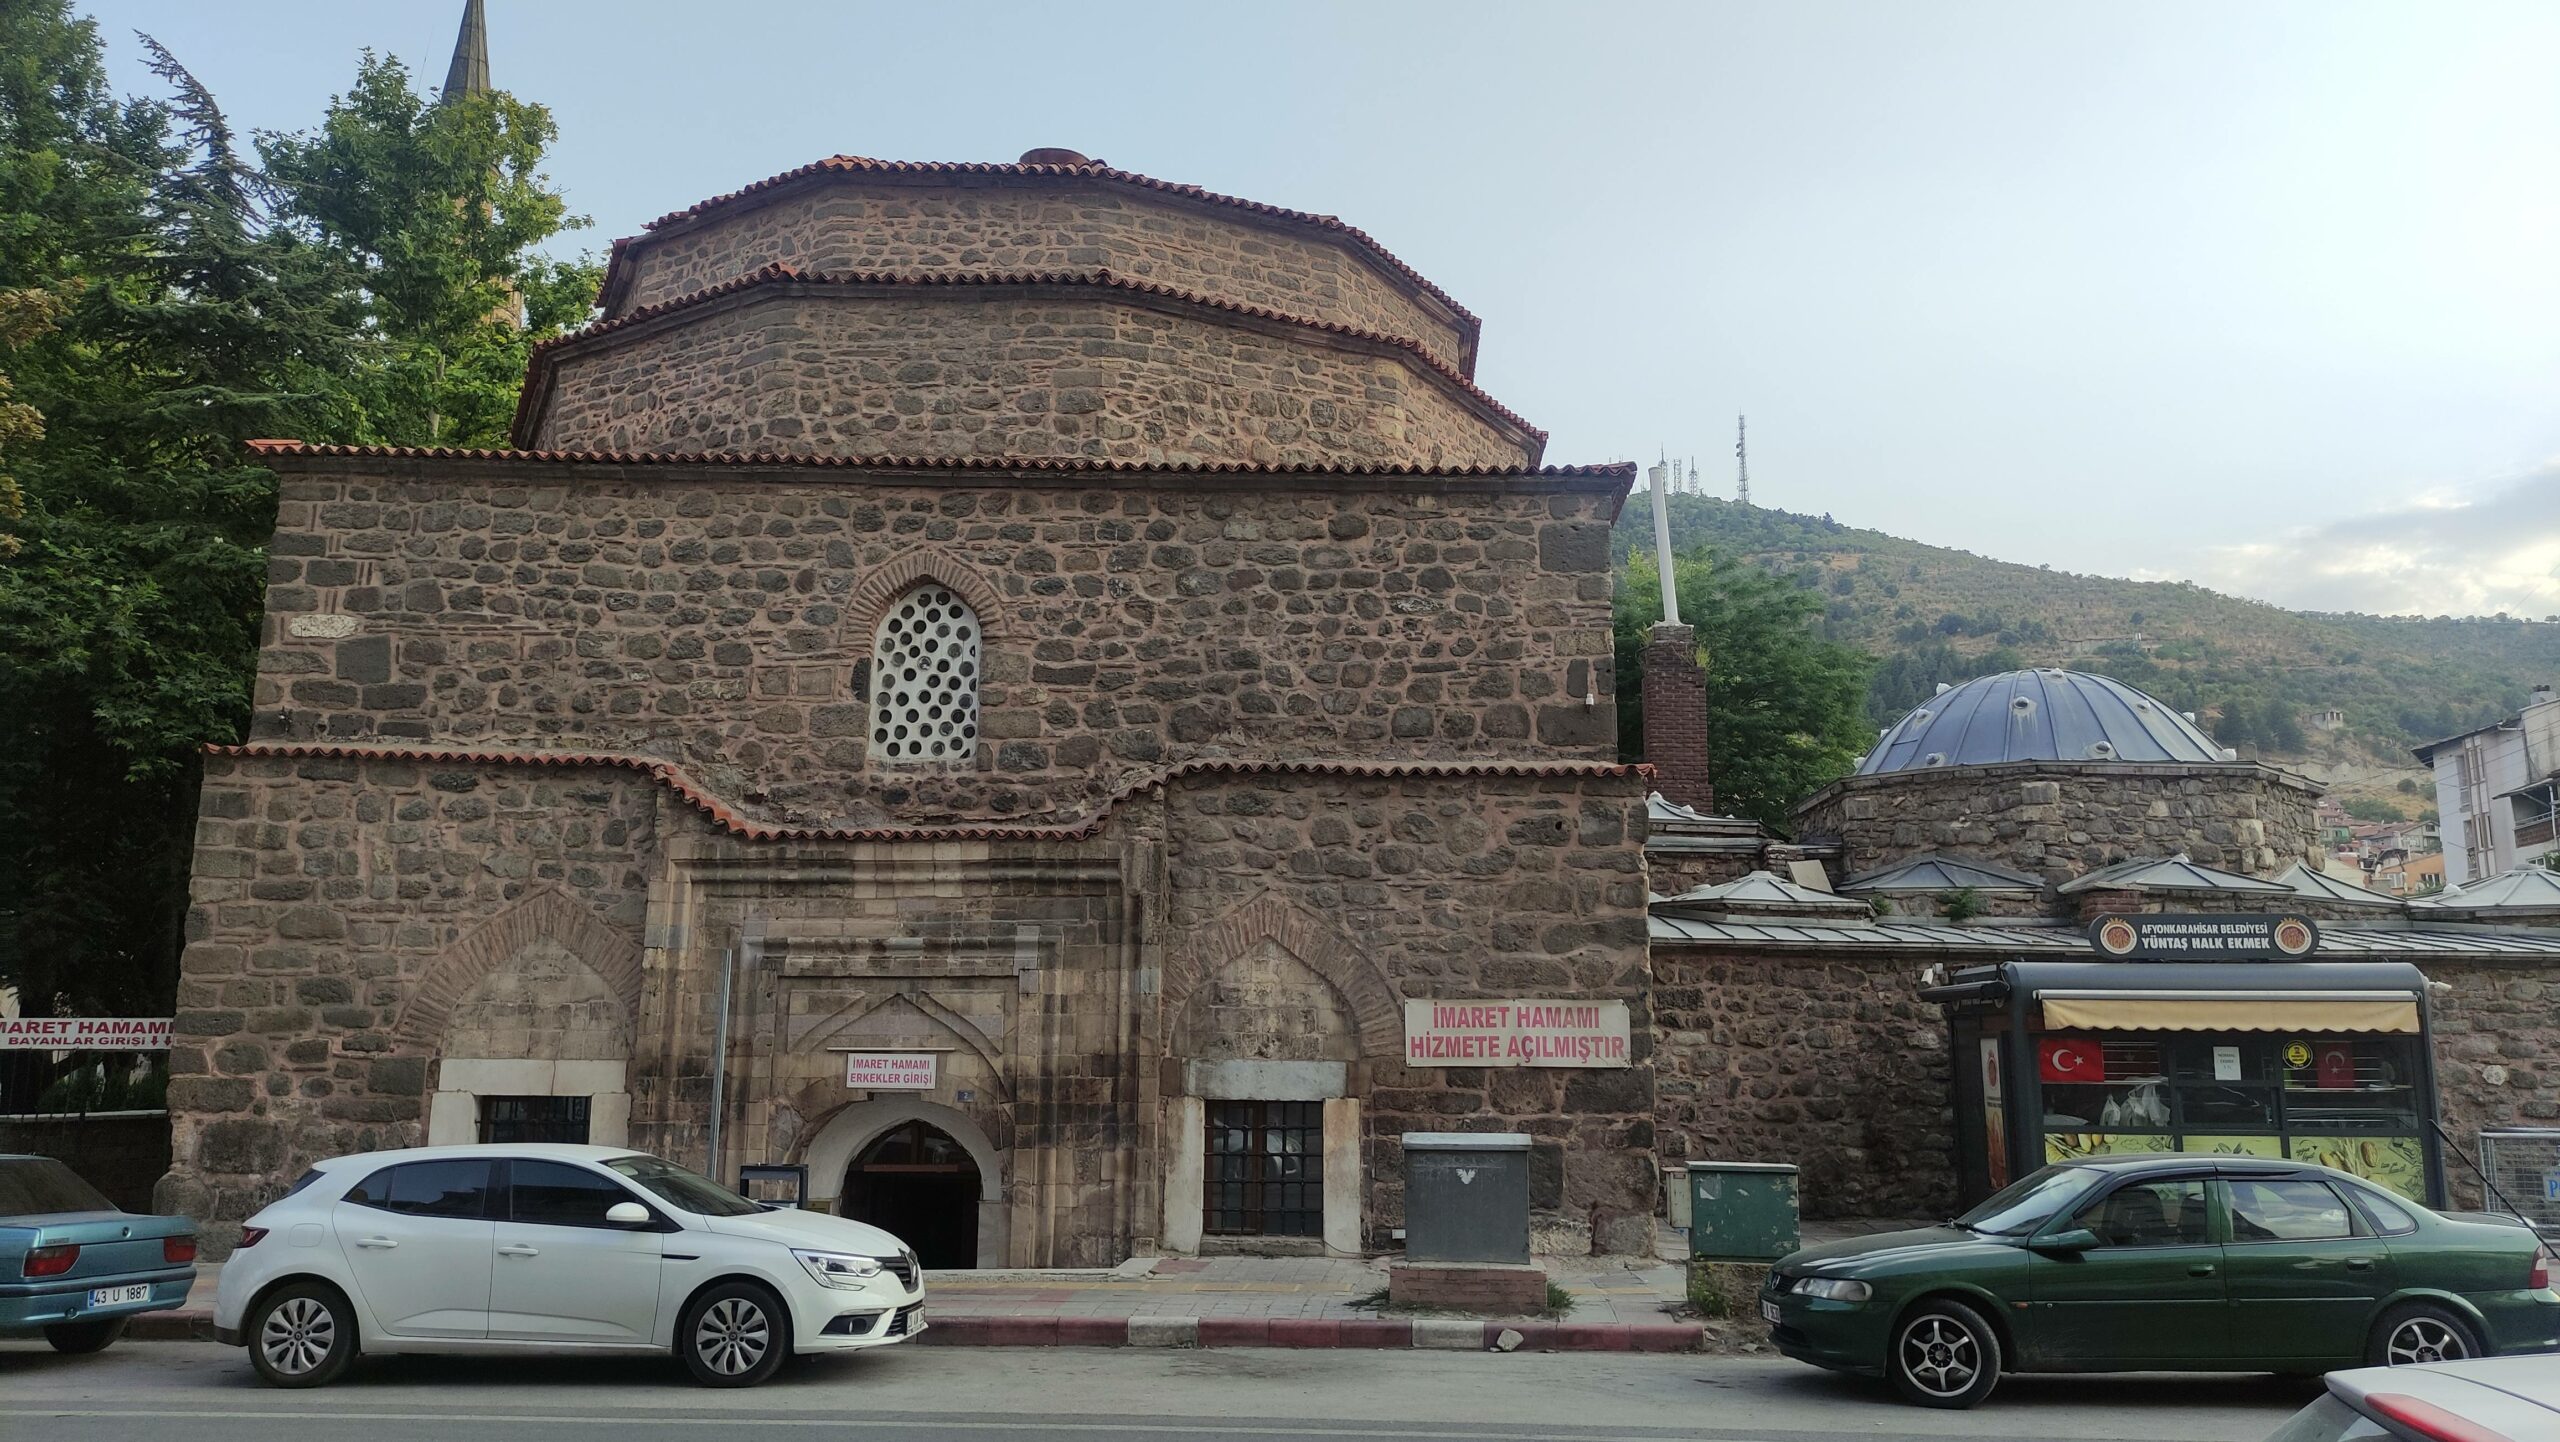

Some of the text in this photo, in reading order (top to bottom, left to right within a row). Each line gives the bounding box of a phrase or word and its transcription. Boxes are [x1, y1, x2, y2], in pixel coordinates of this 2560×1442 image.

[2141, 922, 2268, 934] AFYONKARAHİSAR BELEDİYESİ
[2142, 935, 2270, 951] YÜNTAŞ HALK EKMEK
[1433, 1002, 1599, 1029] İMARET HAMAMI
[8, 1037, 95, 1045] BAYANLAR
[1411, 1031, 1624, 1063] HİZMETE AÇILMIŞTIR
[853, 1056, 930, 1070] İMARET HAMAMI
[850, 1072, 932, 1086] ERKEKLER GİRİŞİ
[94, 1286, 147, 1304] 43 U 1887
